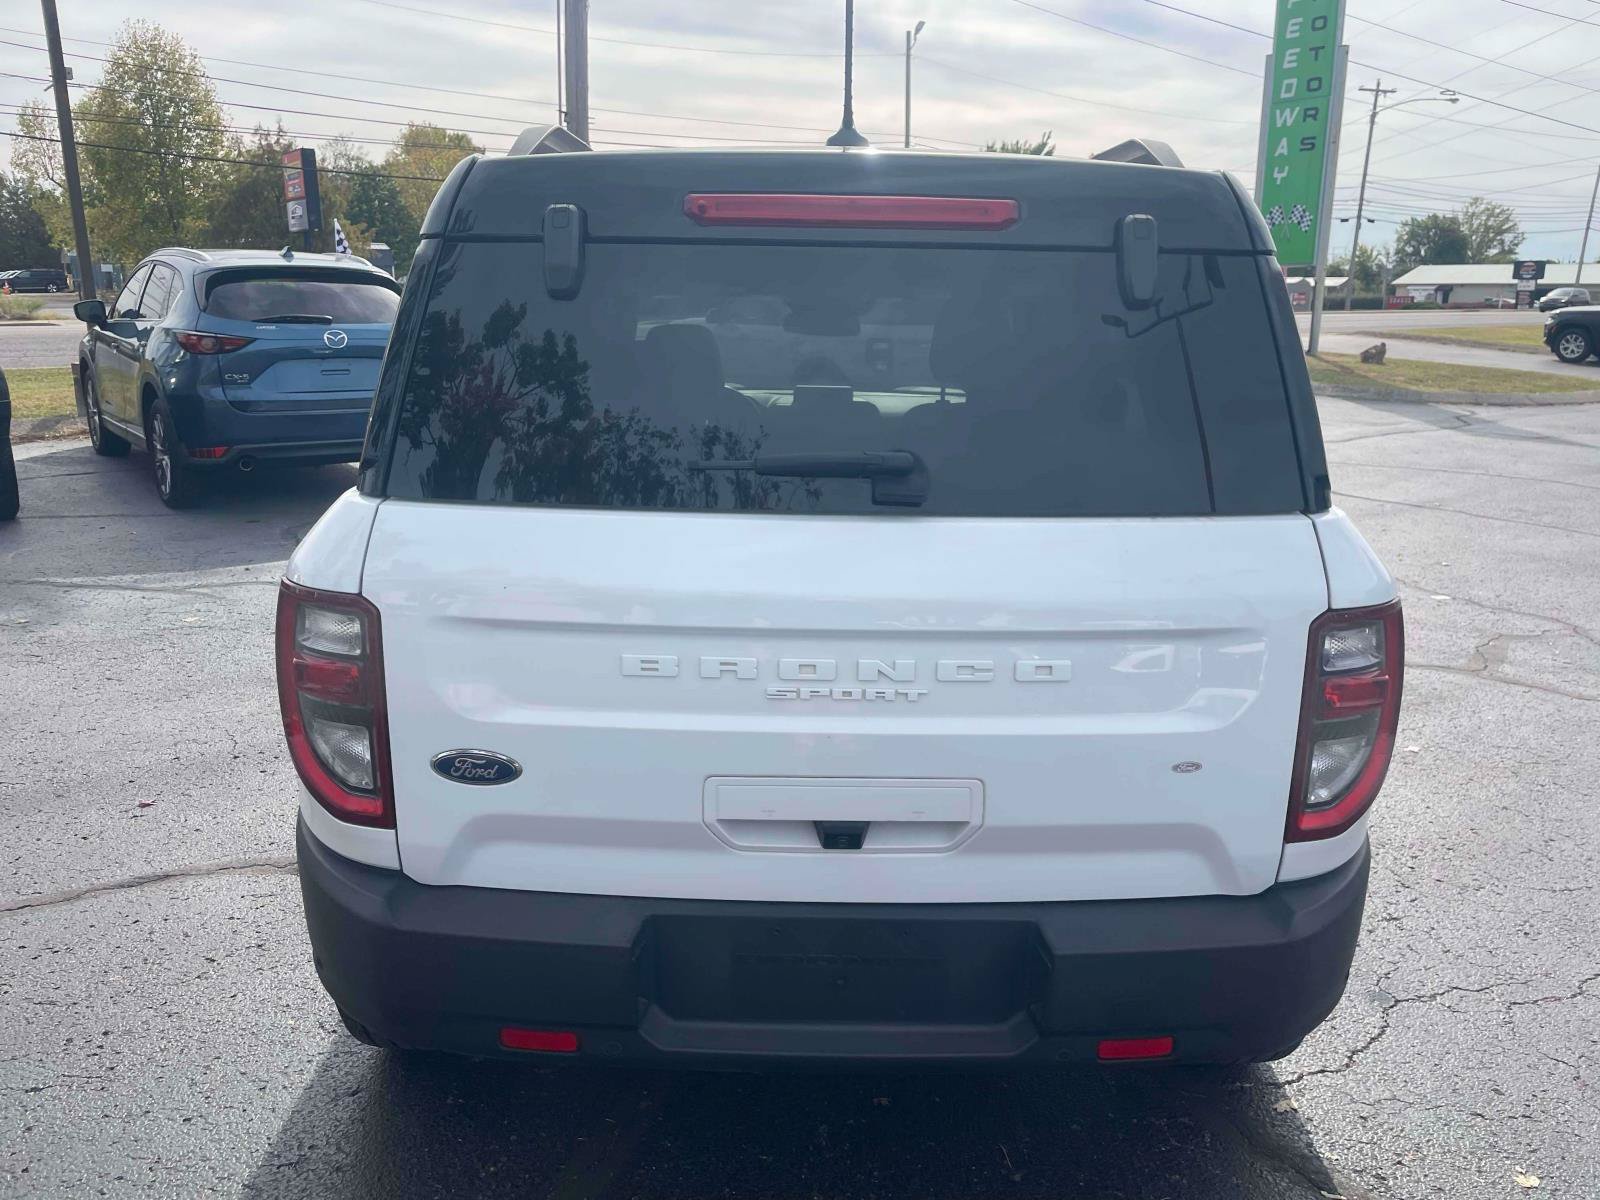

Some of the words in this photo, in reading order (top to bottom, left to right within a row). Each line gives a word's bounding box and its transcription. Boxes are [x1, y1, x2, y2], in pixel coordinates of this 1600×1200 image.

[1299, 0, 1328, 151] OTORS
[620, 654, 1072, 682] BRONCO
[766, 687, 928, 702] SPORT
[450, 757, 499, 779] Ford
